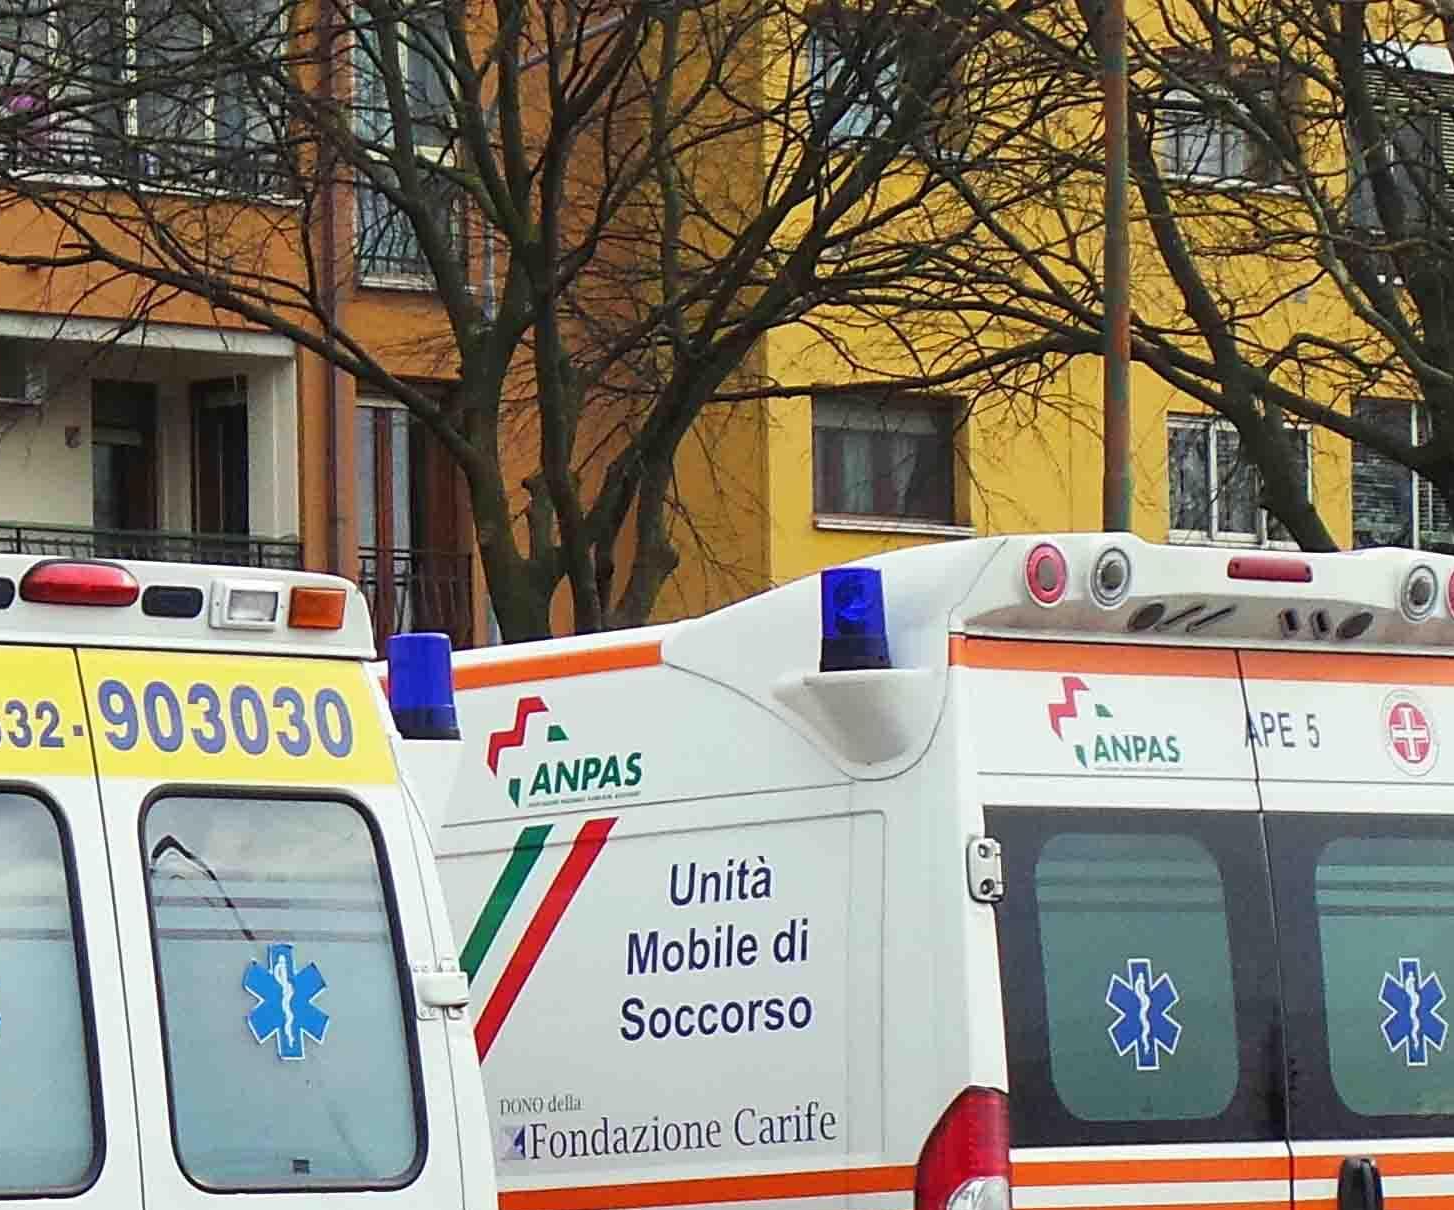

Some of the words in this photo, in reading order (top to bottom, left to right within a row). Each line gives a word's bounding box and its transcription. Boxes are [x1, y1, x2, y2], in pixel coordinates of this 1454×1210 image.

[1094, 734, 1181, 763] ANPAS
[1244, 711, 1297, 748] APE
[1306, 713, 1320, 748] 5
[529, 752, 642, 796] ANPAS
[669, 855, 772, 906] Unità
[626, 923, 758, 976] Mobile
[772, 917, 810, 964] di
[619, 996, 812, 1042] Soccorso
[500, 1097, 544, 1116] DONO
[547, 1092, 582, 1113] della
[529, 1115, 722, 1160] Fondazione
[733, 1100, 838, 1147] Carife
